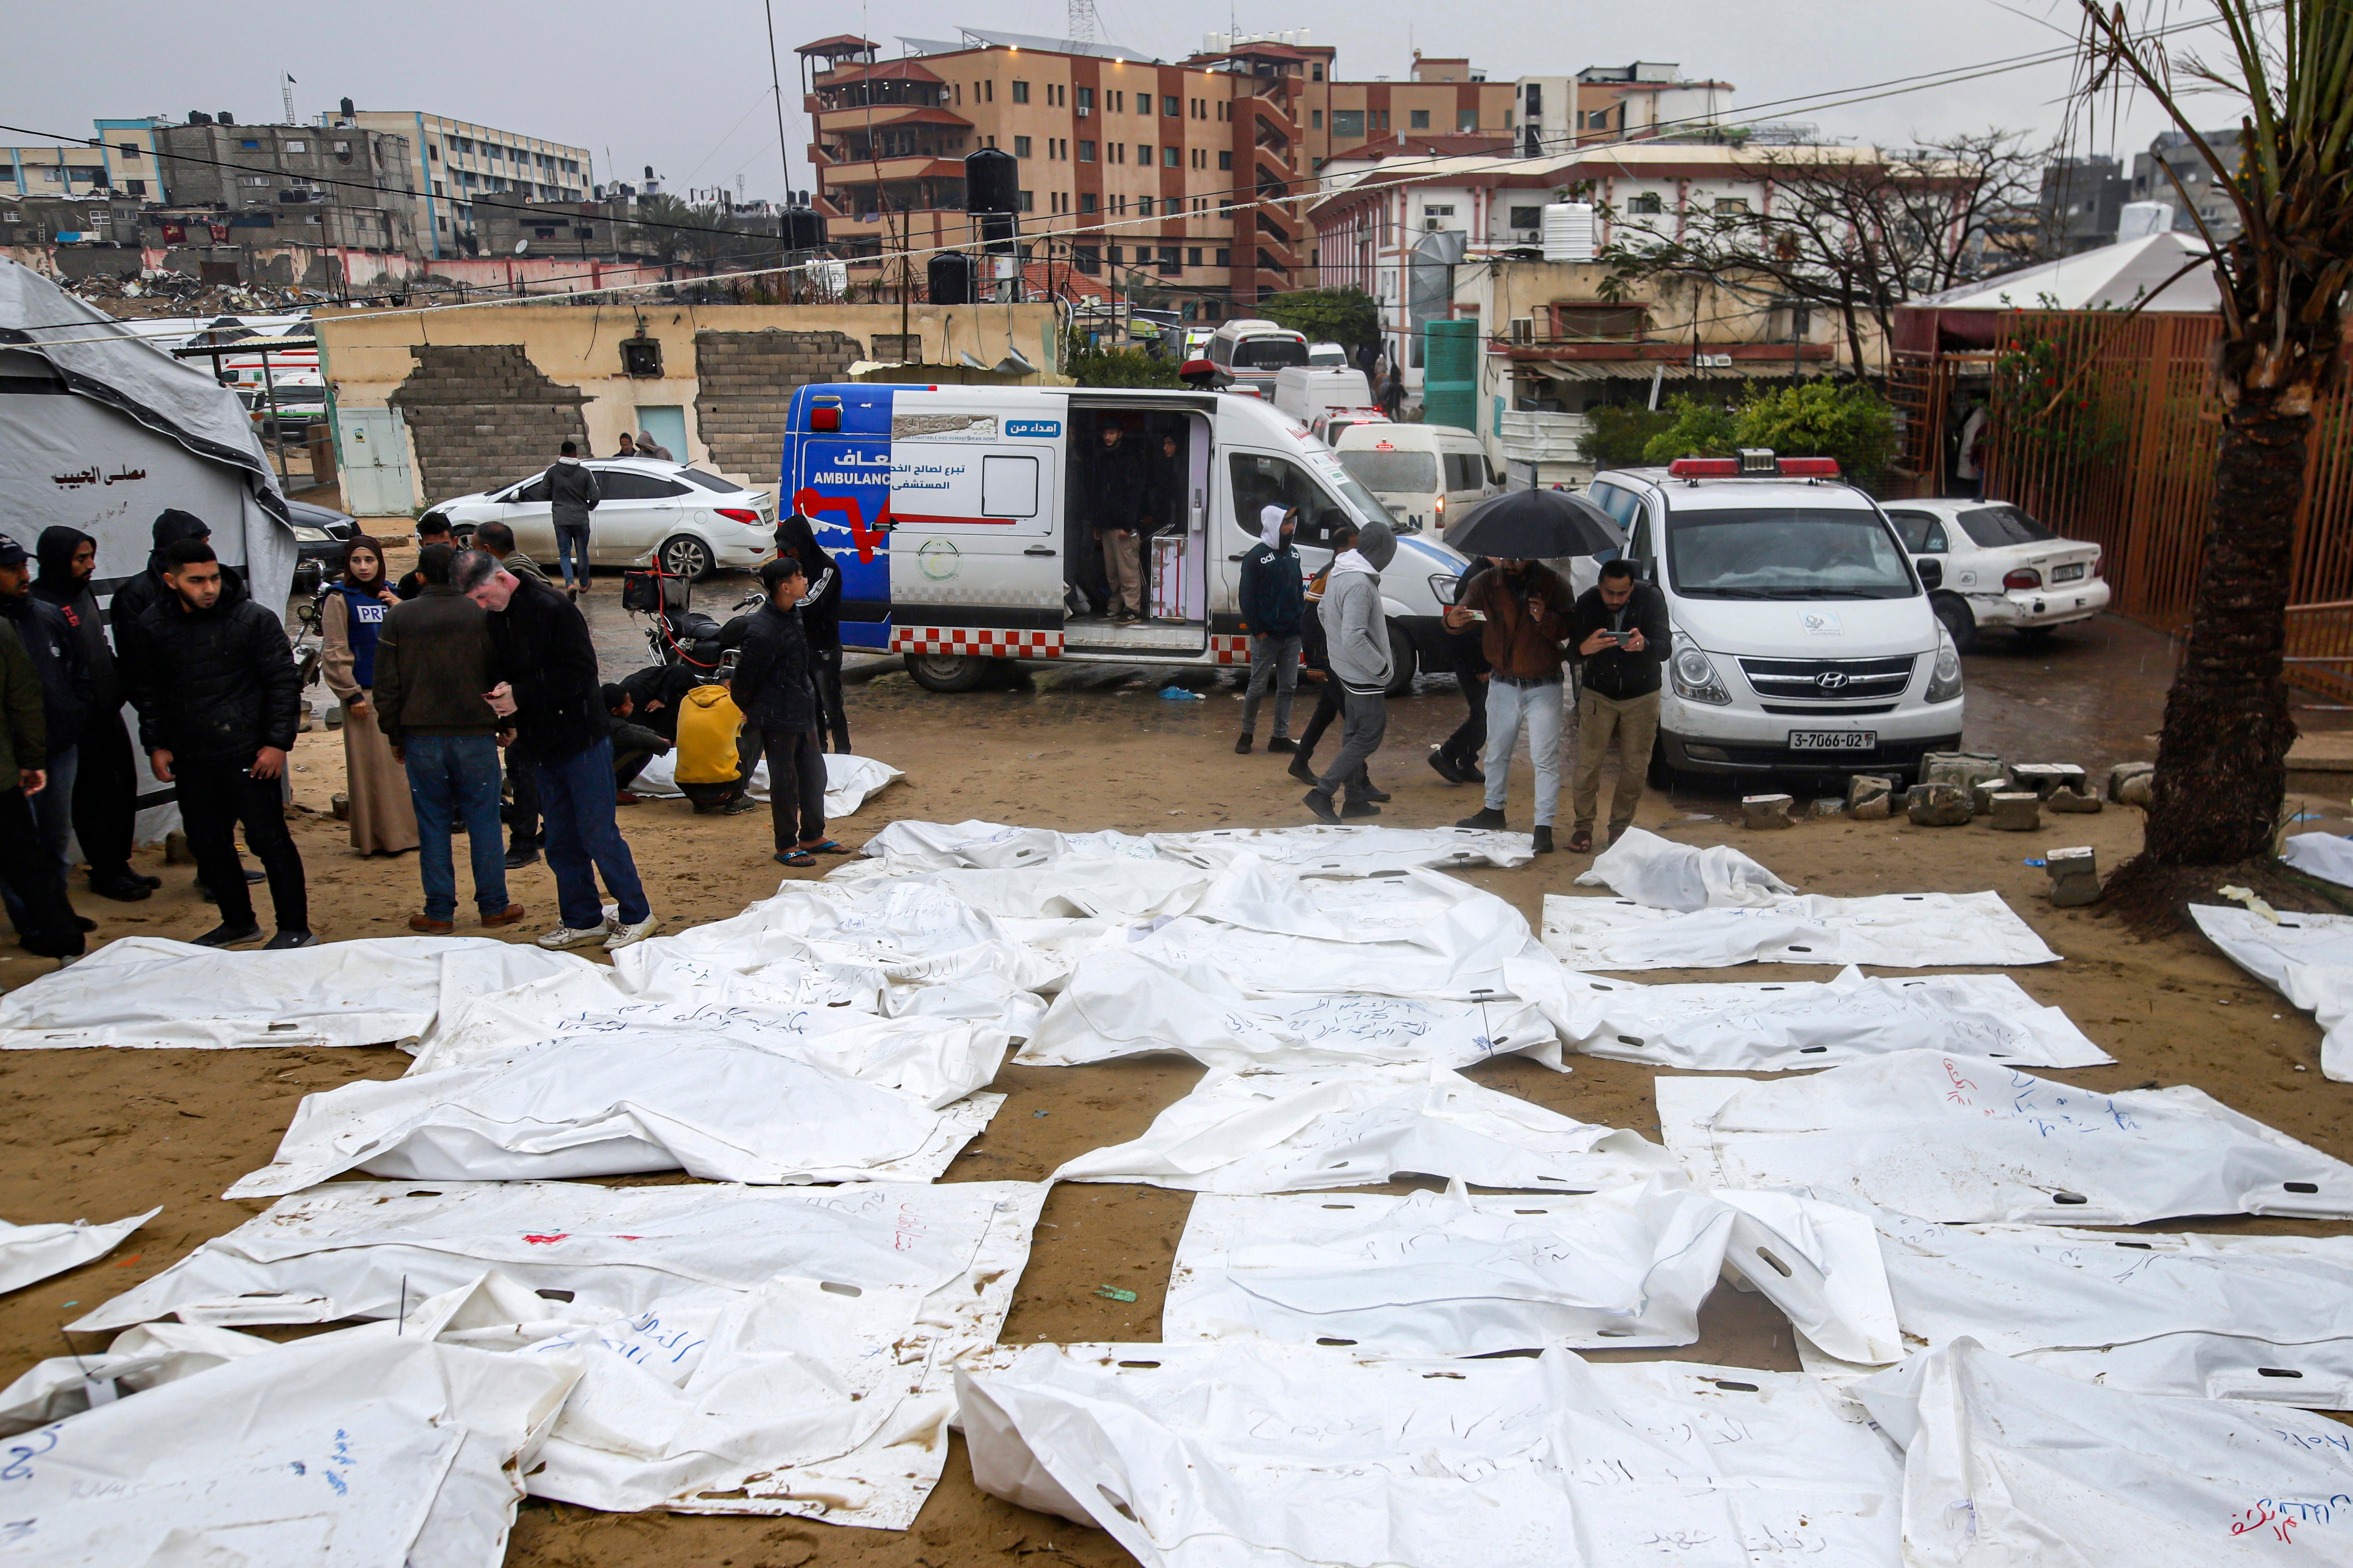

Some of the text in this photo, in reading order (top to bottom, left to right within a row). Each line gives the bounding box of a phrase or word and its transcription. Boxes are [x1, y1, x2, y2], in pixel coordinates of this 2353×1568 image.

[1011, 423, 1057, 435] إهداء من
[104, 463, 146, 486] مصلى
[890, 464, 966, 476] تبرع لصالح الخد
[813, 472, 891, 485] AMBULANC
[891, 480, 950, 490] المستشفى
[1408, 514, 1423, 530] N
[361, 607, 387, 620] PRE
[1795, 734, 1862, 747] 3-7066-02
